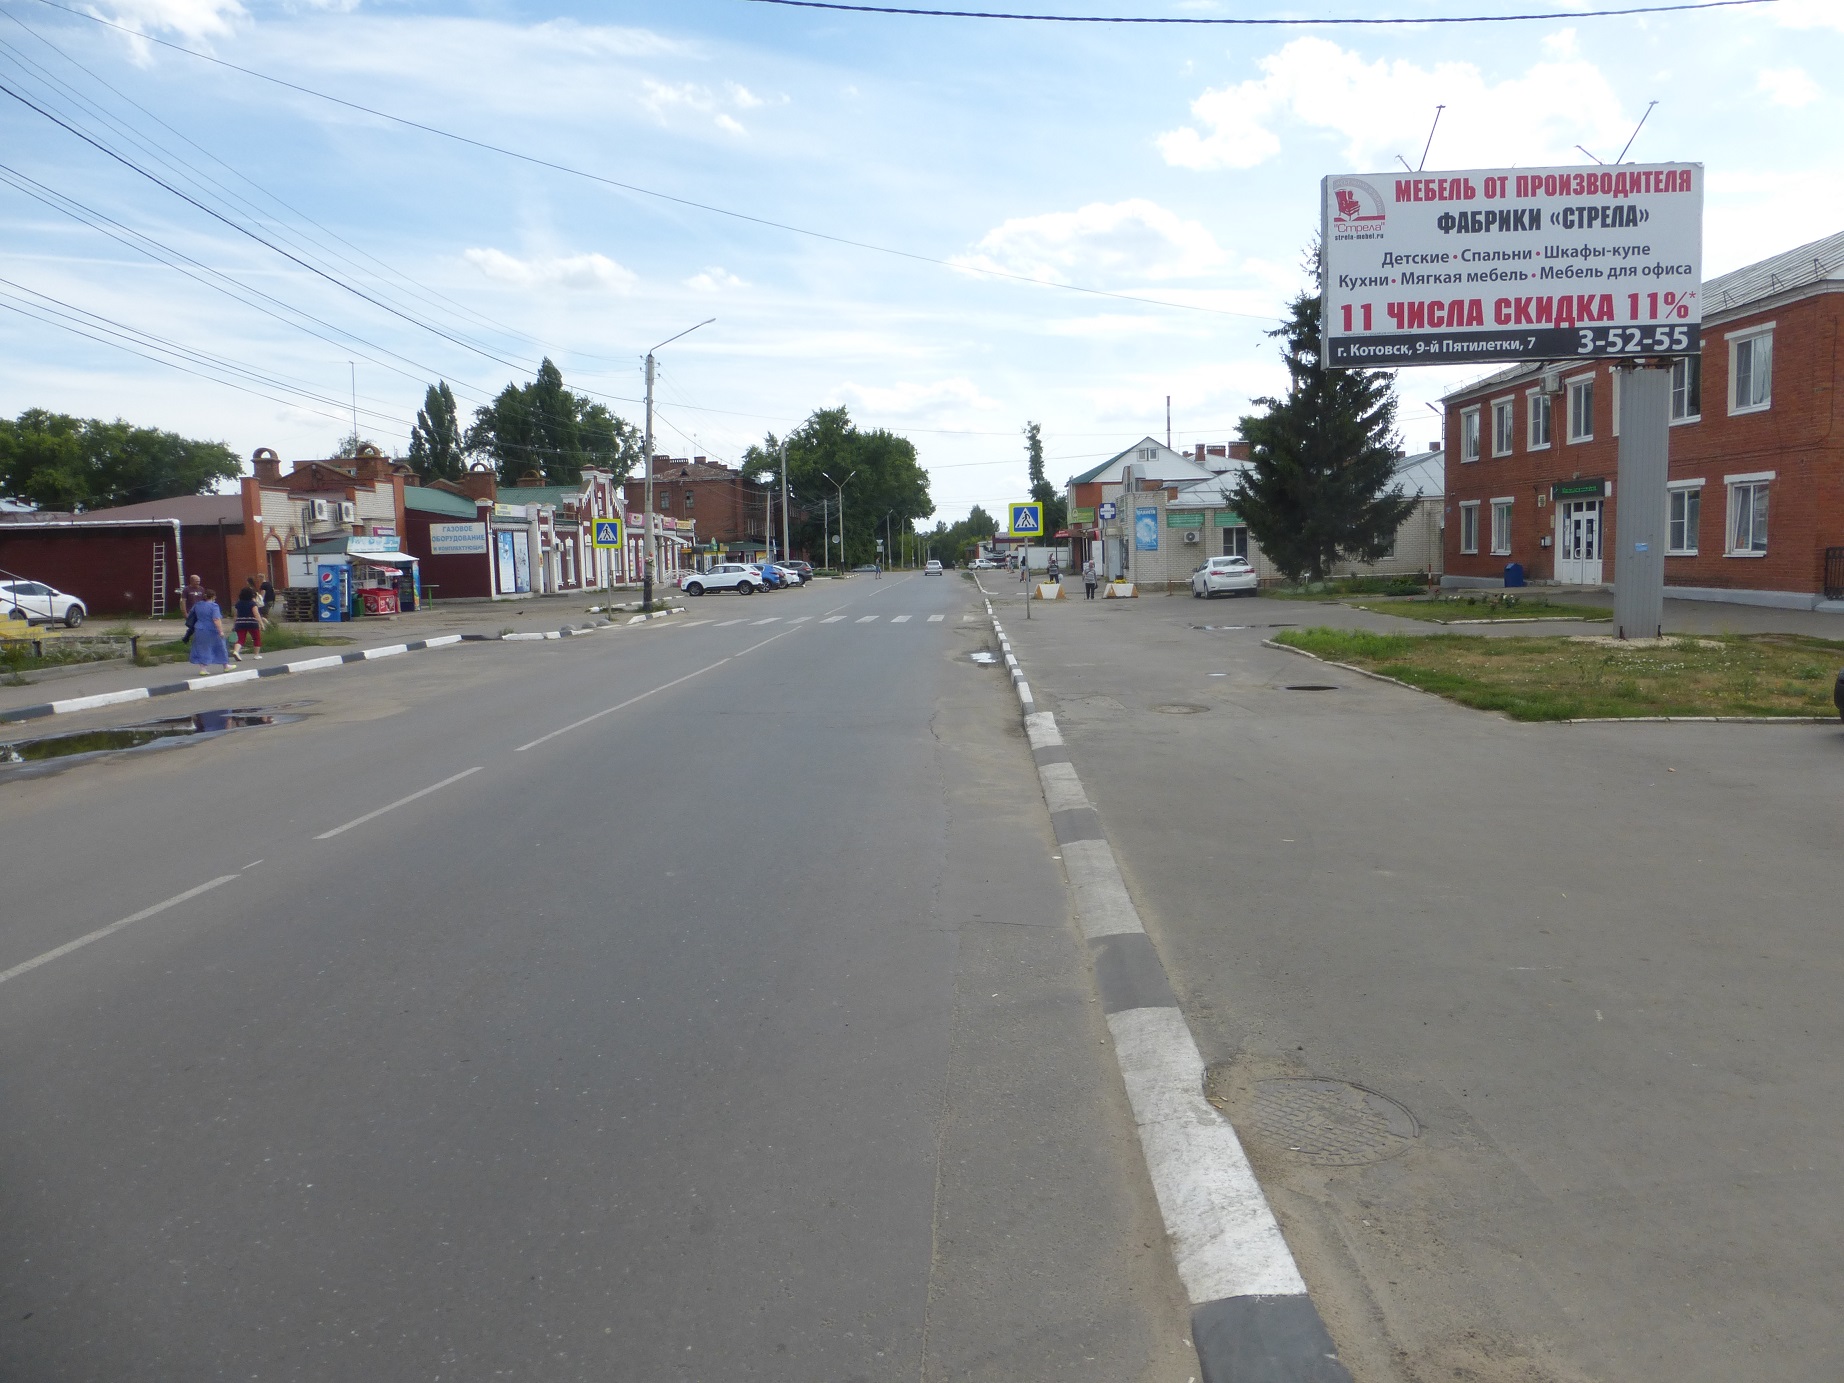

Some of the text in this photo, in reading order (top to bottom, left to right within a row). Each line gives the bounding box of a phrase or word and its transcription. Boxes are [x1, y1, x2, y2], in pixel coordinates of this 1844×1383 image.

[1395, 178, 1476, 202] МЕБЕЛЬ
[1484, 176, 1508, 199] ОТ
[1516, 170, 1691, 198] ПРОИЗВОДИТЕЛЯ
[1437, 205, 1649, 234] ФАБРИКИ «СТРЕЛА»
[1382, 243, 1650, 268] Детские Спальни Шкафы-купе
[1339, 261, 1692, 290] Кухни Мягкая мебель Мебель для офиса
[1341, 302, 1372, 332] 11
[1387, 298, 1484, 329] ЧИСЛА
[1494, 293, 1614, 328] СКИДКА
[1337, 337, 1536, 358] г. Котовск, 9-й Пятилетки, 7
[1578, 326, 1689, 354] 3-52-55
